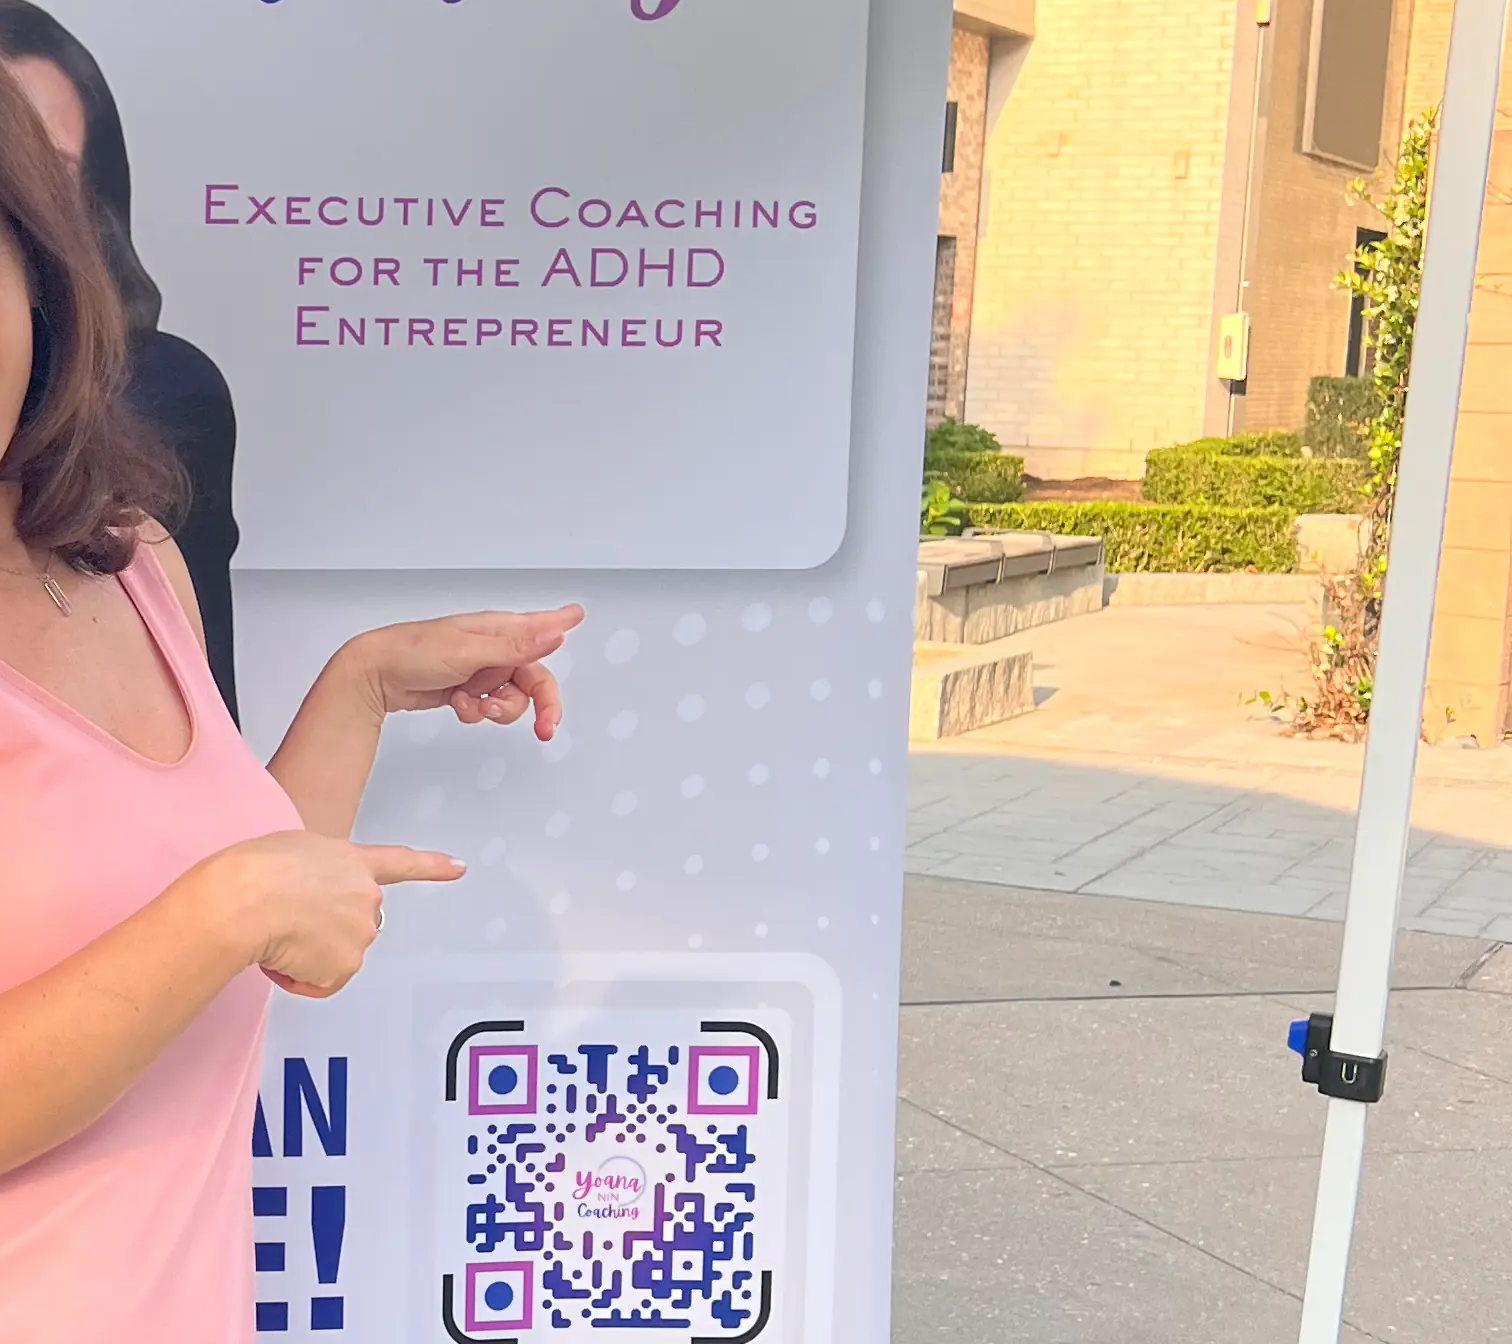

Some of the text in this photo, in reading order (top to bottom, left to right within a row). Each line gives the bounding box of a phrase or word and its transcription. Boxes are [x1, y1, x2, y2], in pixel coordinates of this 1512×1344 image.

[204, 184, 818, 229] EXECUTIVE COACHING
[297, 248, 725, 288] FOR THE ADHD
[295, 305, 723, 347] ENTREPRENEUR
[572, 1171, 643, 1200] Yoana
[597, 1192, 619, 1202] NIN
[577, 1203, 639, 1220] Coaching
